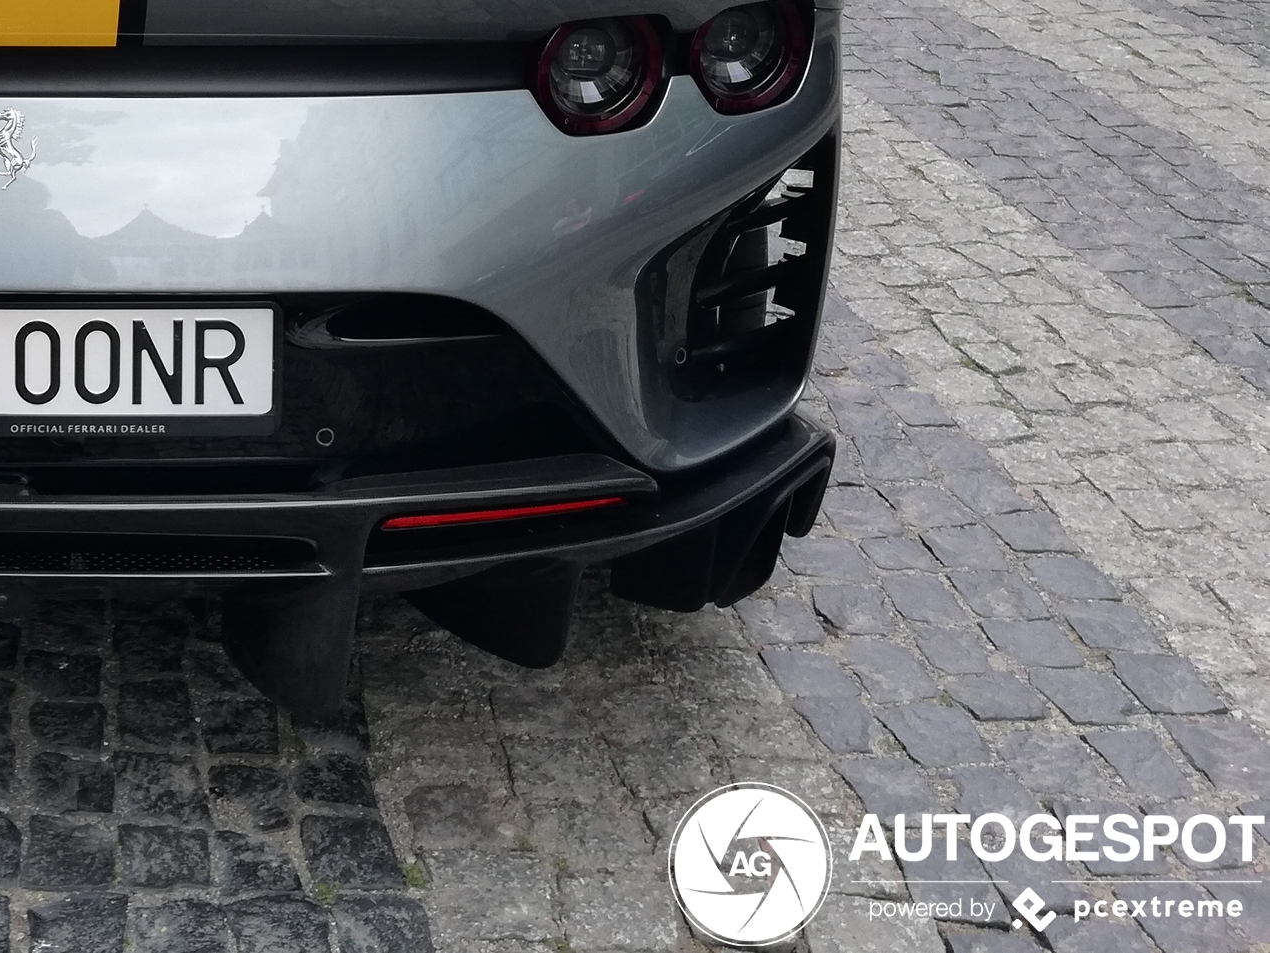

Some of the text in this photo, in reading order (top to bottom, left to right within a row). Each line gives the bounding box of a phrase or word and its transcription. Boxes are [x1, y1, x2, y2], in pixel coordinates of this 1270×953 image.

[10, 424, 166, 434] OFFICIAL FERRARI DEALER
